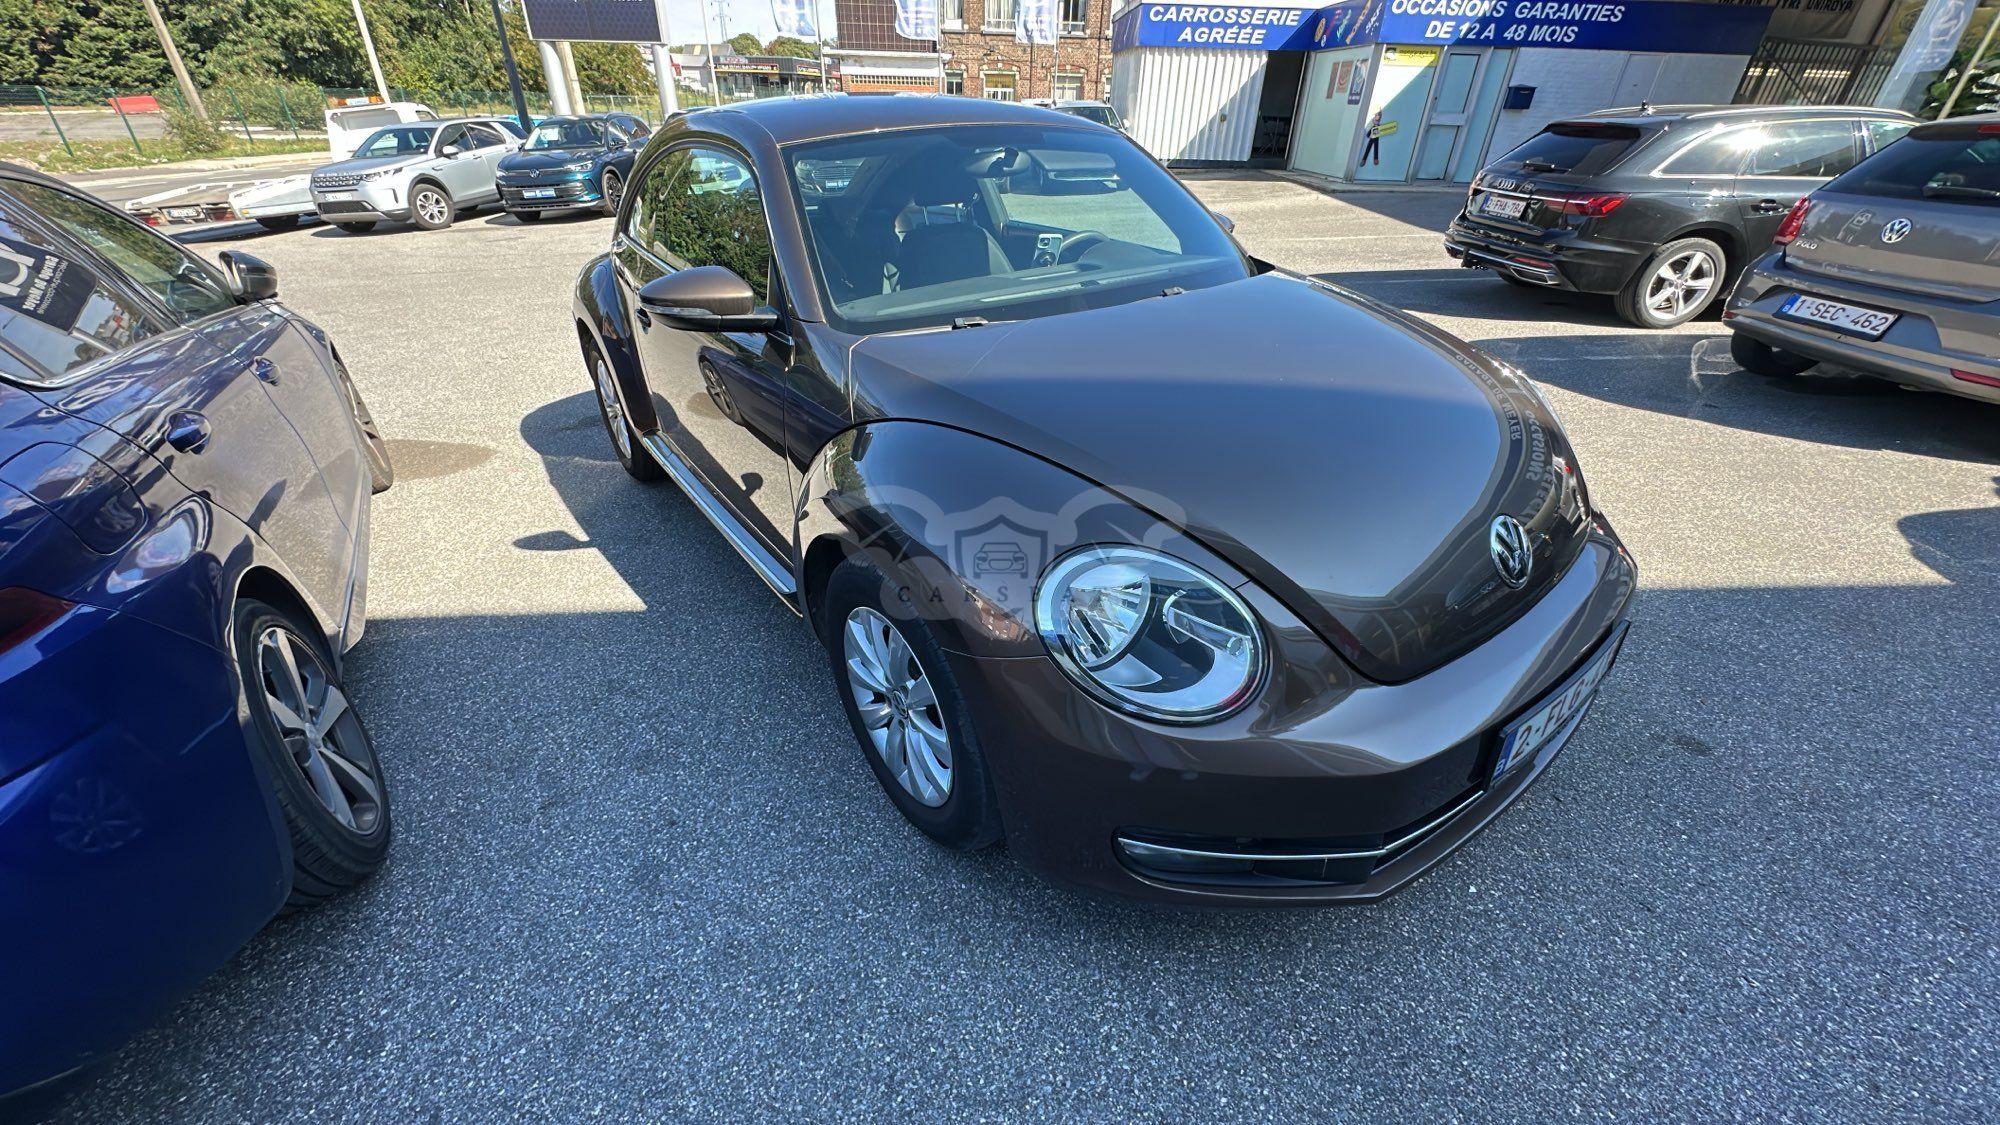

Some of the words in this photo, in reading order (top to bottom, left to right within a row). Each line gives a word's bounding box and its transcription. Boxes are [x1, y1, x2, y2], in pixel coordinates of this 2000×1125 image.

[1150, 6, 1302, 26] CARROSSERIE
[1391, 0, 1508, 17] OCCASIONS
[1514, 2, 1625, 23] GARANTIES
[1177, 26, 1266, 45] AGRÉÉE
[1424, 21, 1456, 39] DE
[1459, 21, 1477, 39] 12
[1480, 23, 1495, 40] A
[1503, 24, 1526, 41] 48
[1528, 25, 1579, 43] MOIS
[1796, 240, 1818, 250] POLO
[1795, 298, 1889, 332] 1-SEC-462
